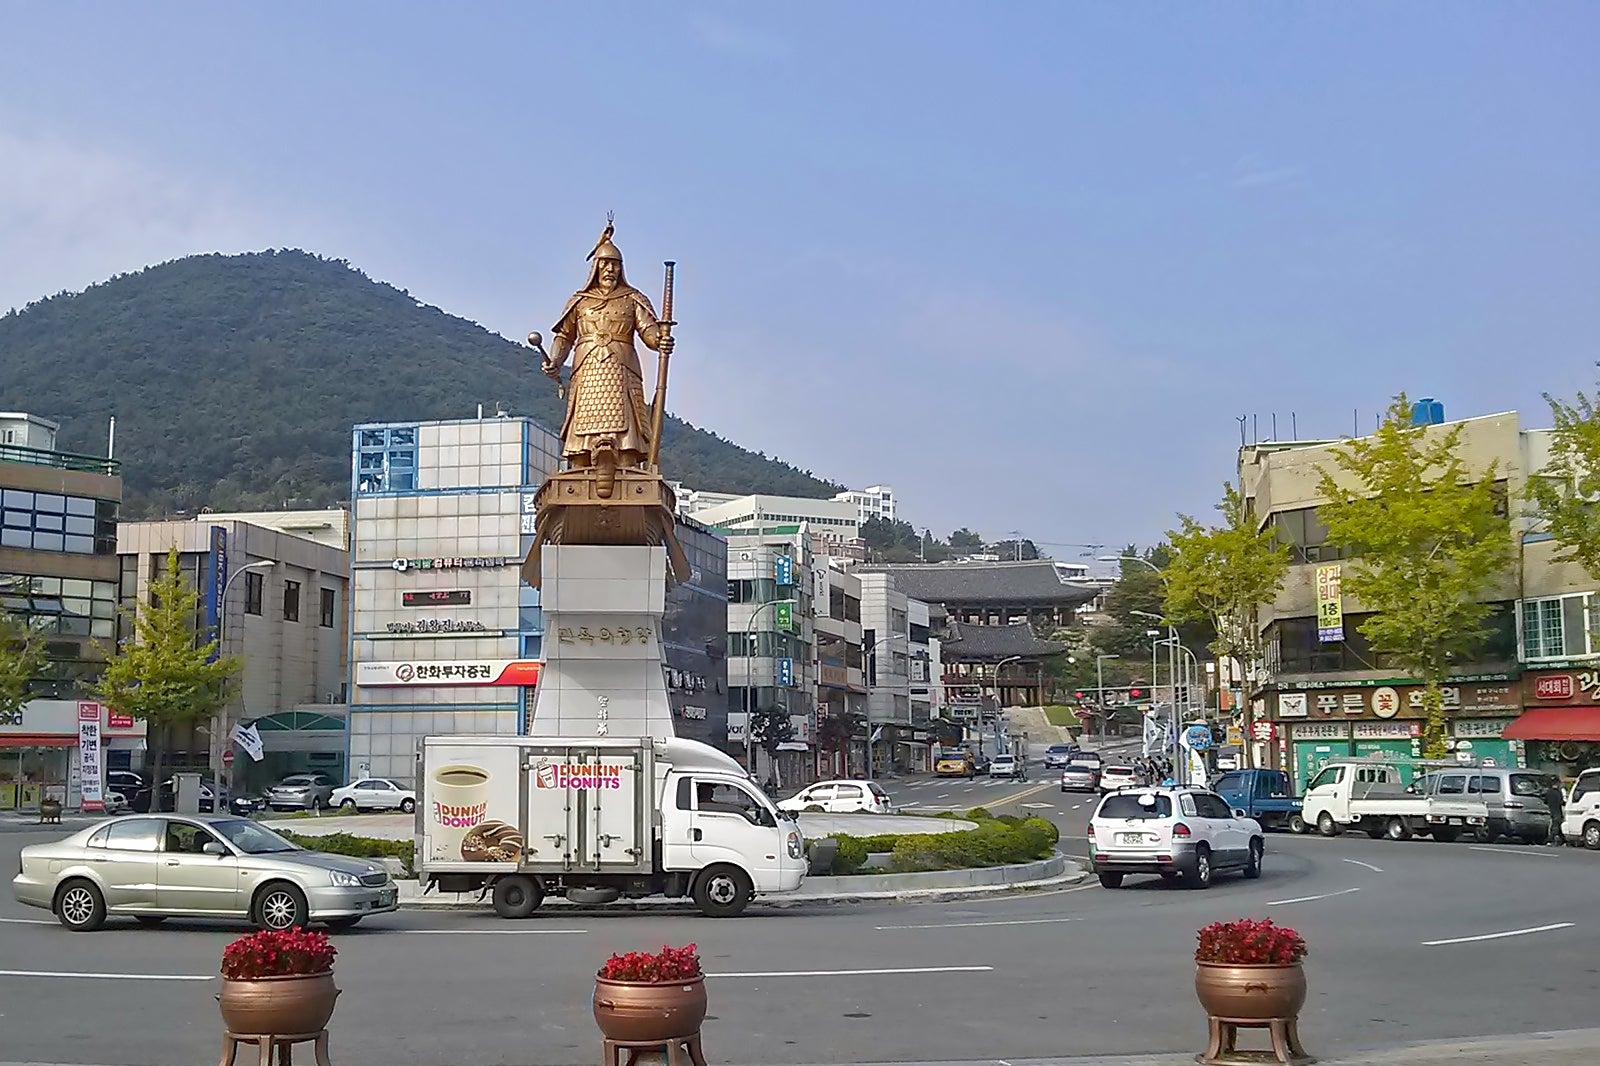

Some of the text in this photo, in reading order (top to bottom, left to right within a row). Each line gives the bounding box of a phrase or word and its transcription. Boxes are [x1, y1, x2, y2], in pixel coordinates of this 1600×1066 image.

[1321, 602, 1338, 616] 1층
[416, 664, 491, 679] 한화투자증권
[1317, 694, 1364, 714] 푸른
[1378, 694, 1392, 711] 꽃
[81, 725, 97, 737] 착한
[1253, 722, 1272, 740] 꽃
[82, 740, 97, 751] 기변
[560, 764, 623, 777] DUNKIN'
[560, 777, 620, 789] DONUTS
